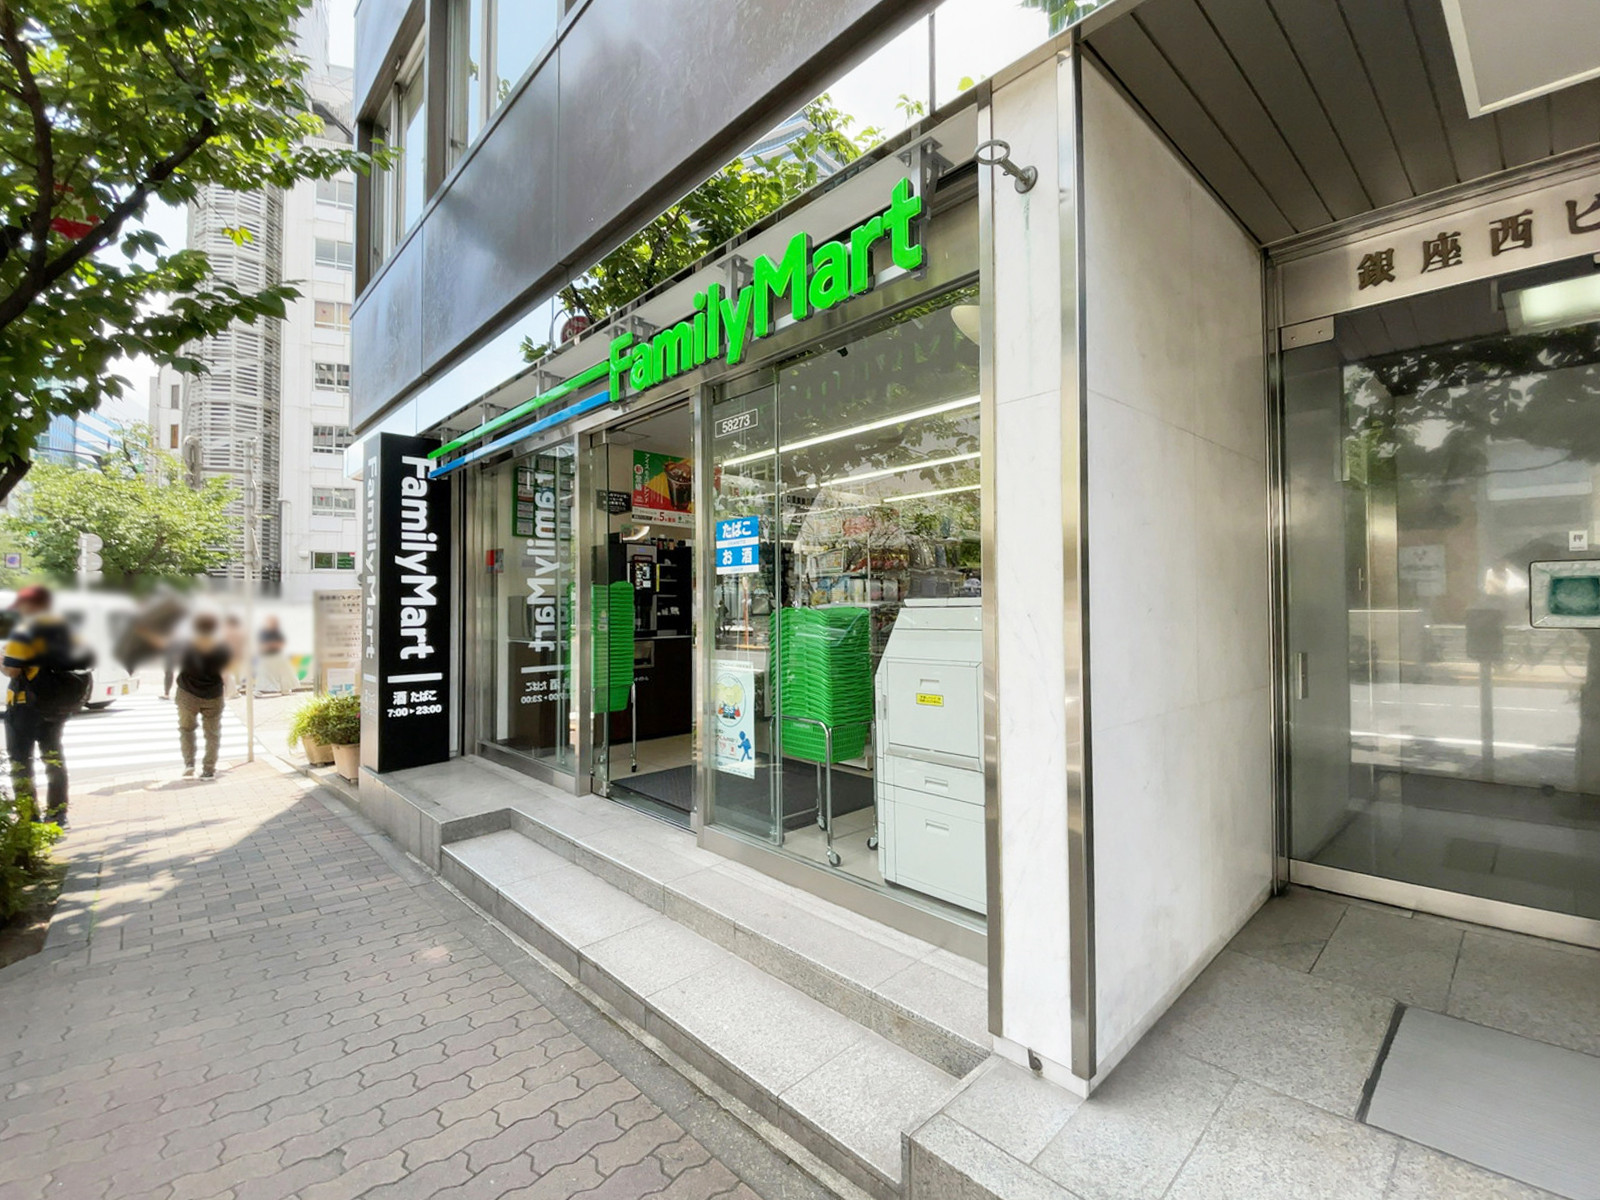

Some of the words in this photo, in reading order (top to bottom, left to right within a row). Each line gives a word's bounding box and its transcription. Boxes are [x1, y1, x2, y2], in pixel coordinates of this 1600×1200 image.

[609, 177, 922, 402] FamilyMart
[722, 414, 750, 433] 58273
[722, 520, 752, 539] たばこ
[365, 456, 377, 660] FamilyMart
[394, 455, 438, 660] FamilyMart
[392, 690, 408, 706] 酒
[410, 689, 438, 703] たばこ
[386, 707, 409, 718] 7:00
[415, 704, 443, 715] 23:00
